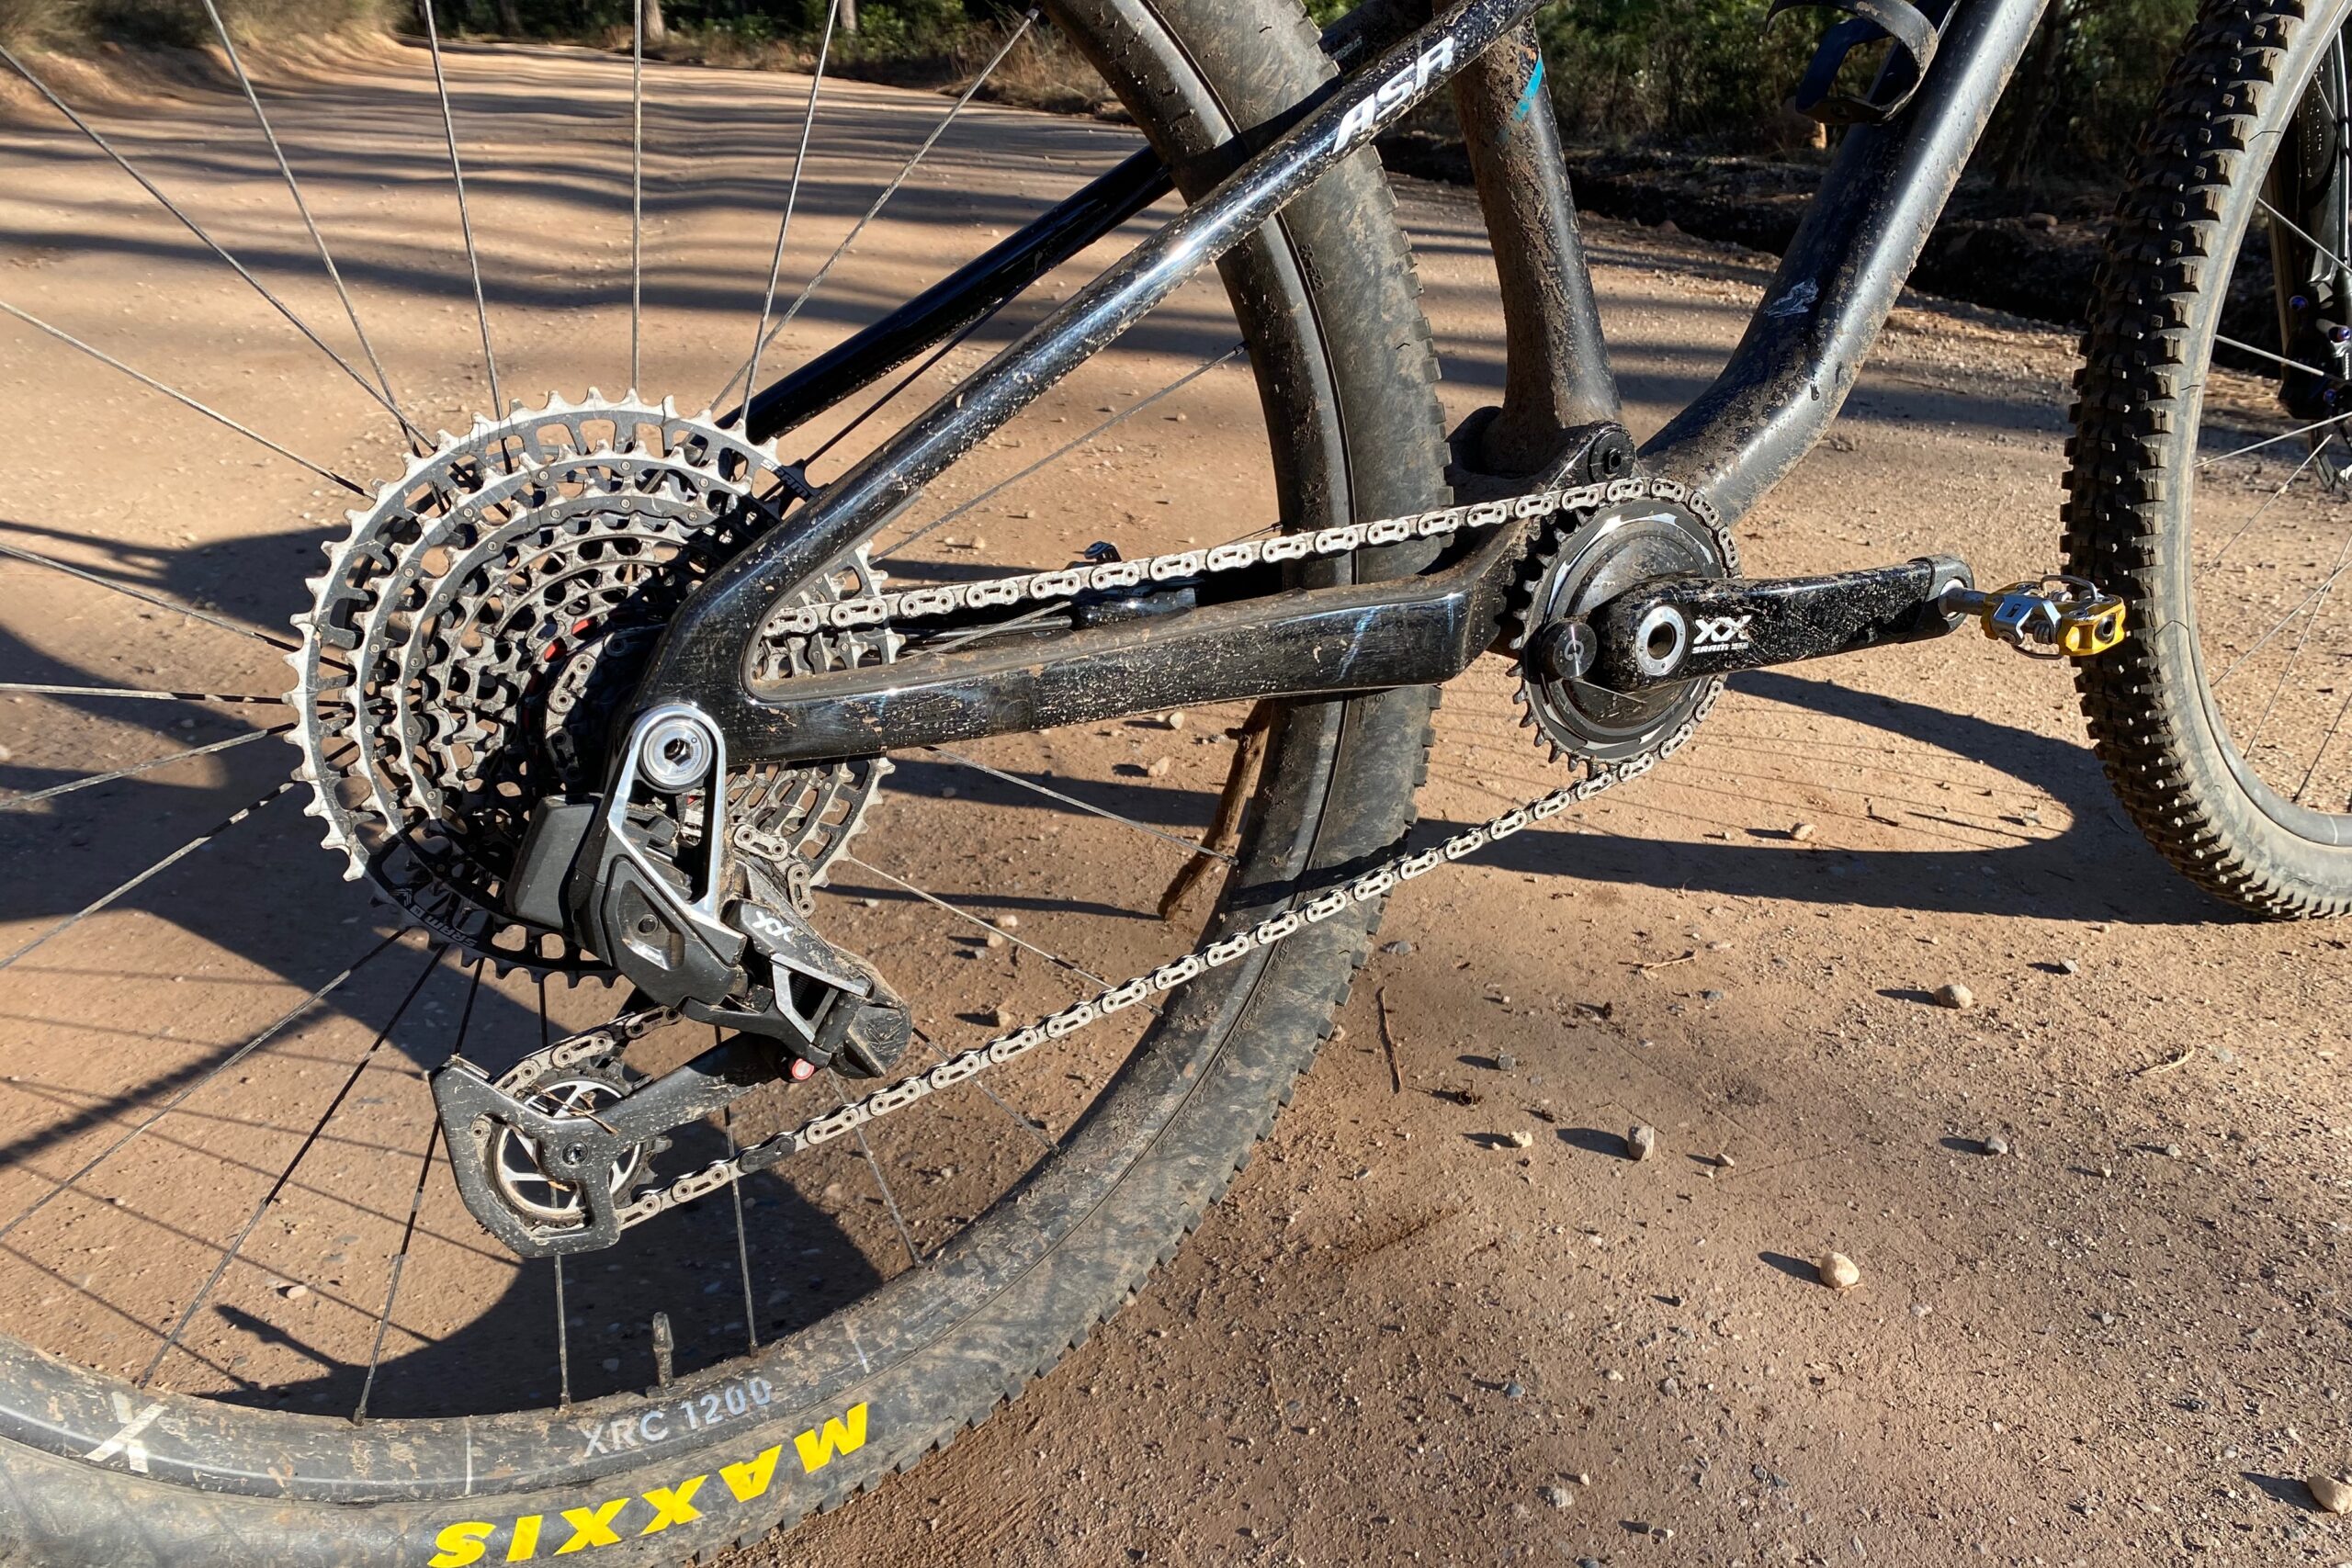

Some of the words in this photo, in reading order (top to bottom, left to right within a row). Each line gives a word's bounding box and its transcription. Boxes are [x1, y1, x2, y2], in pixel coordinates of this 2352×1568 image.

[1332, 36, 1454, 154] ASR
[761, 458, 808, 497] SRAM
[1693, 615, 1752, 644] XX
[1691, 643, 1730, 654] SRAM
[424, 915, 478, 948] SRAM
[752, 910, 794, 943] XX
[581, 1412, 669, 1457] XRC
[680, 1377, 771, 1430] 1200
[427, 1402, 867, 1567] MAXXIS
